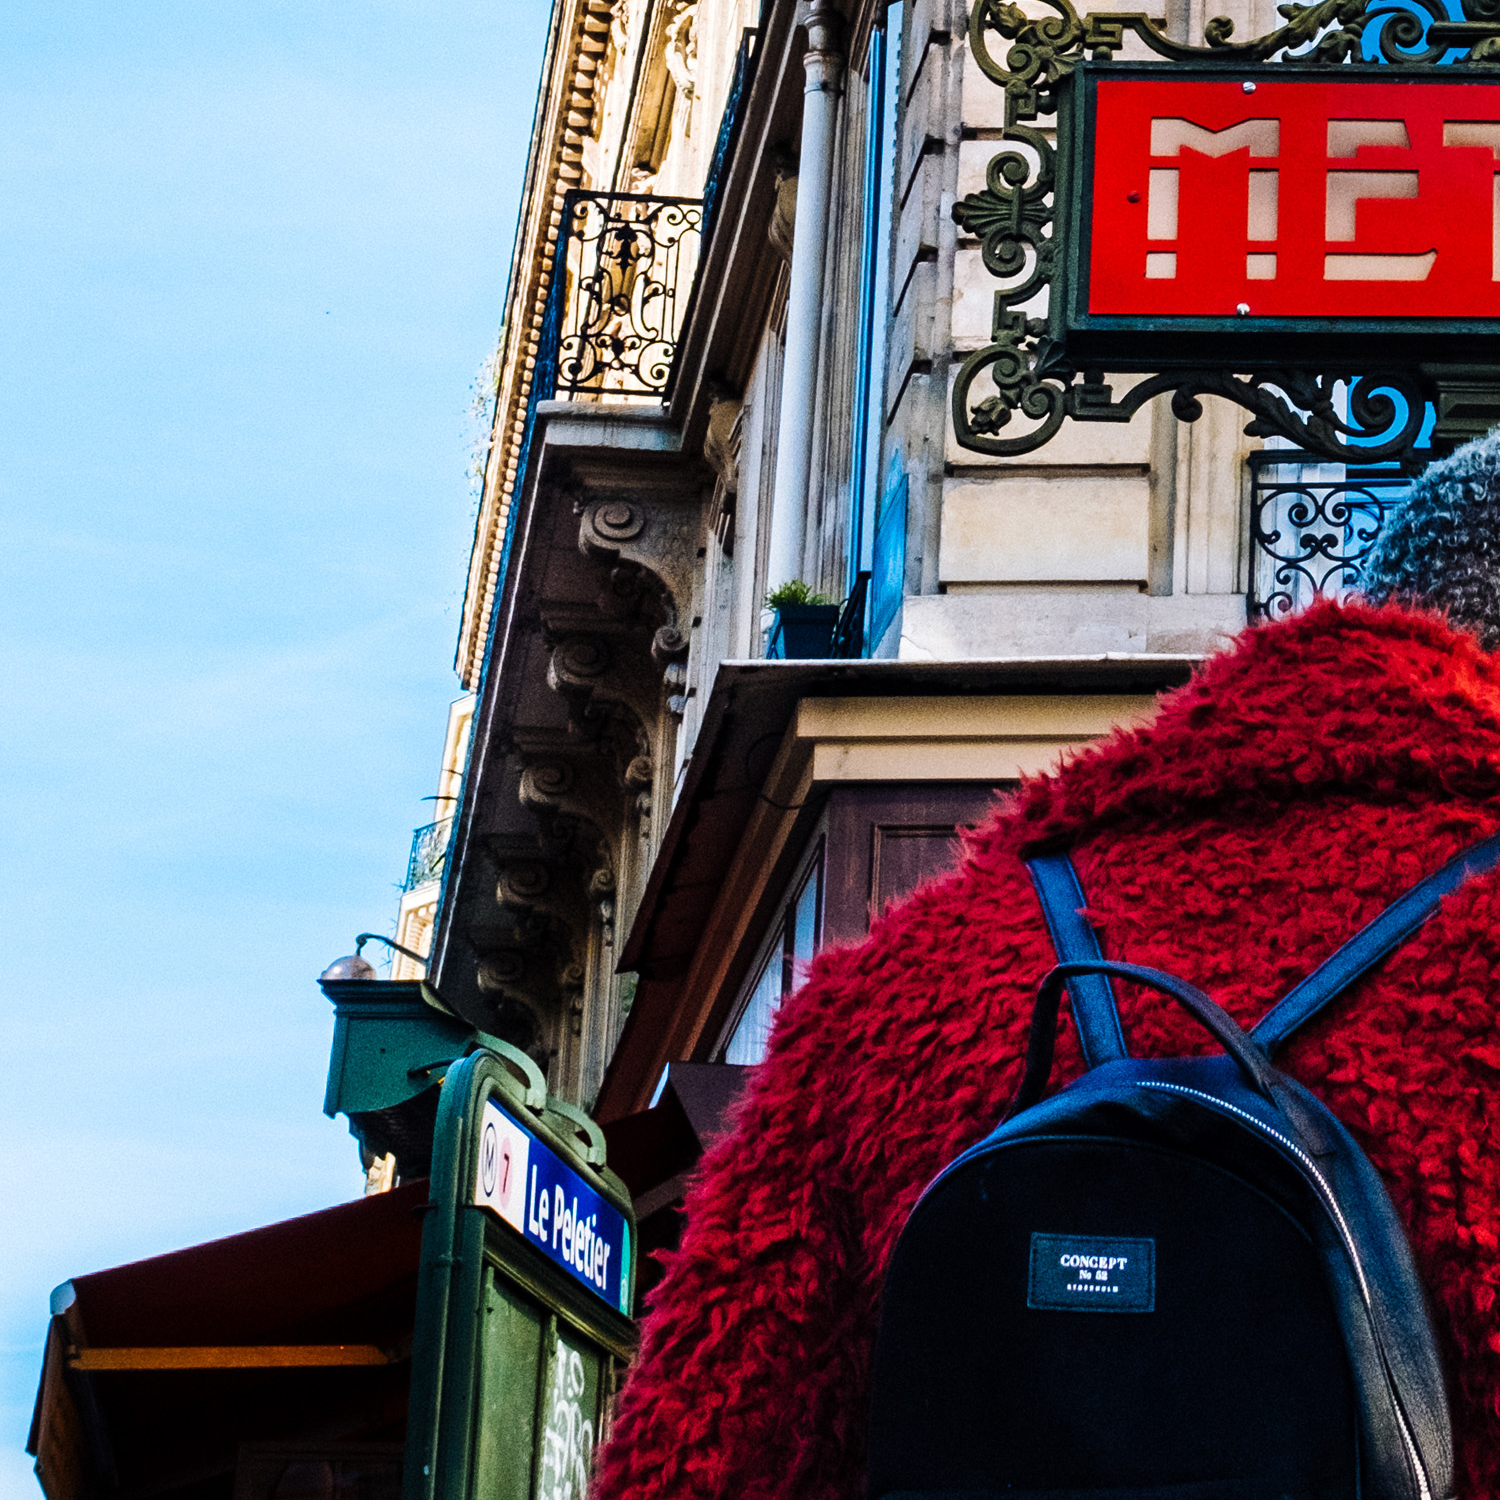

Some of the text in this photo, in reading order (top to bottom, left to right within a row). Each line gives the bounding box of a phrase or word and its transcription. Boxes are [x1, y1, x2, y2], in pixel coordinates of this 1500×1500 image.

[528, 1164, 611, 1291] Le Peletier
[1060, 1254, 1128, 1270] CONCEPT
